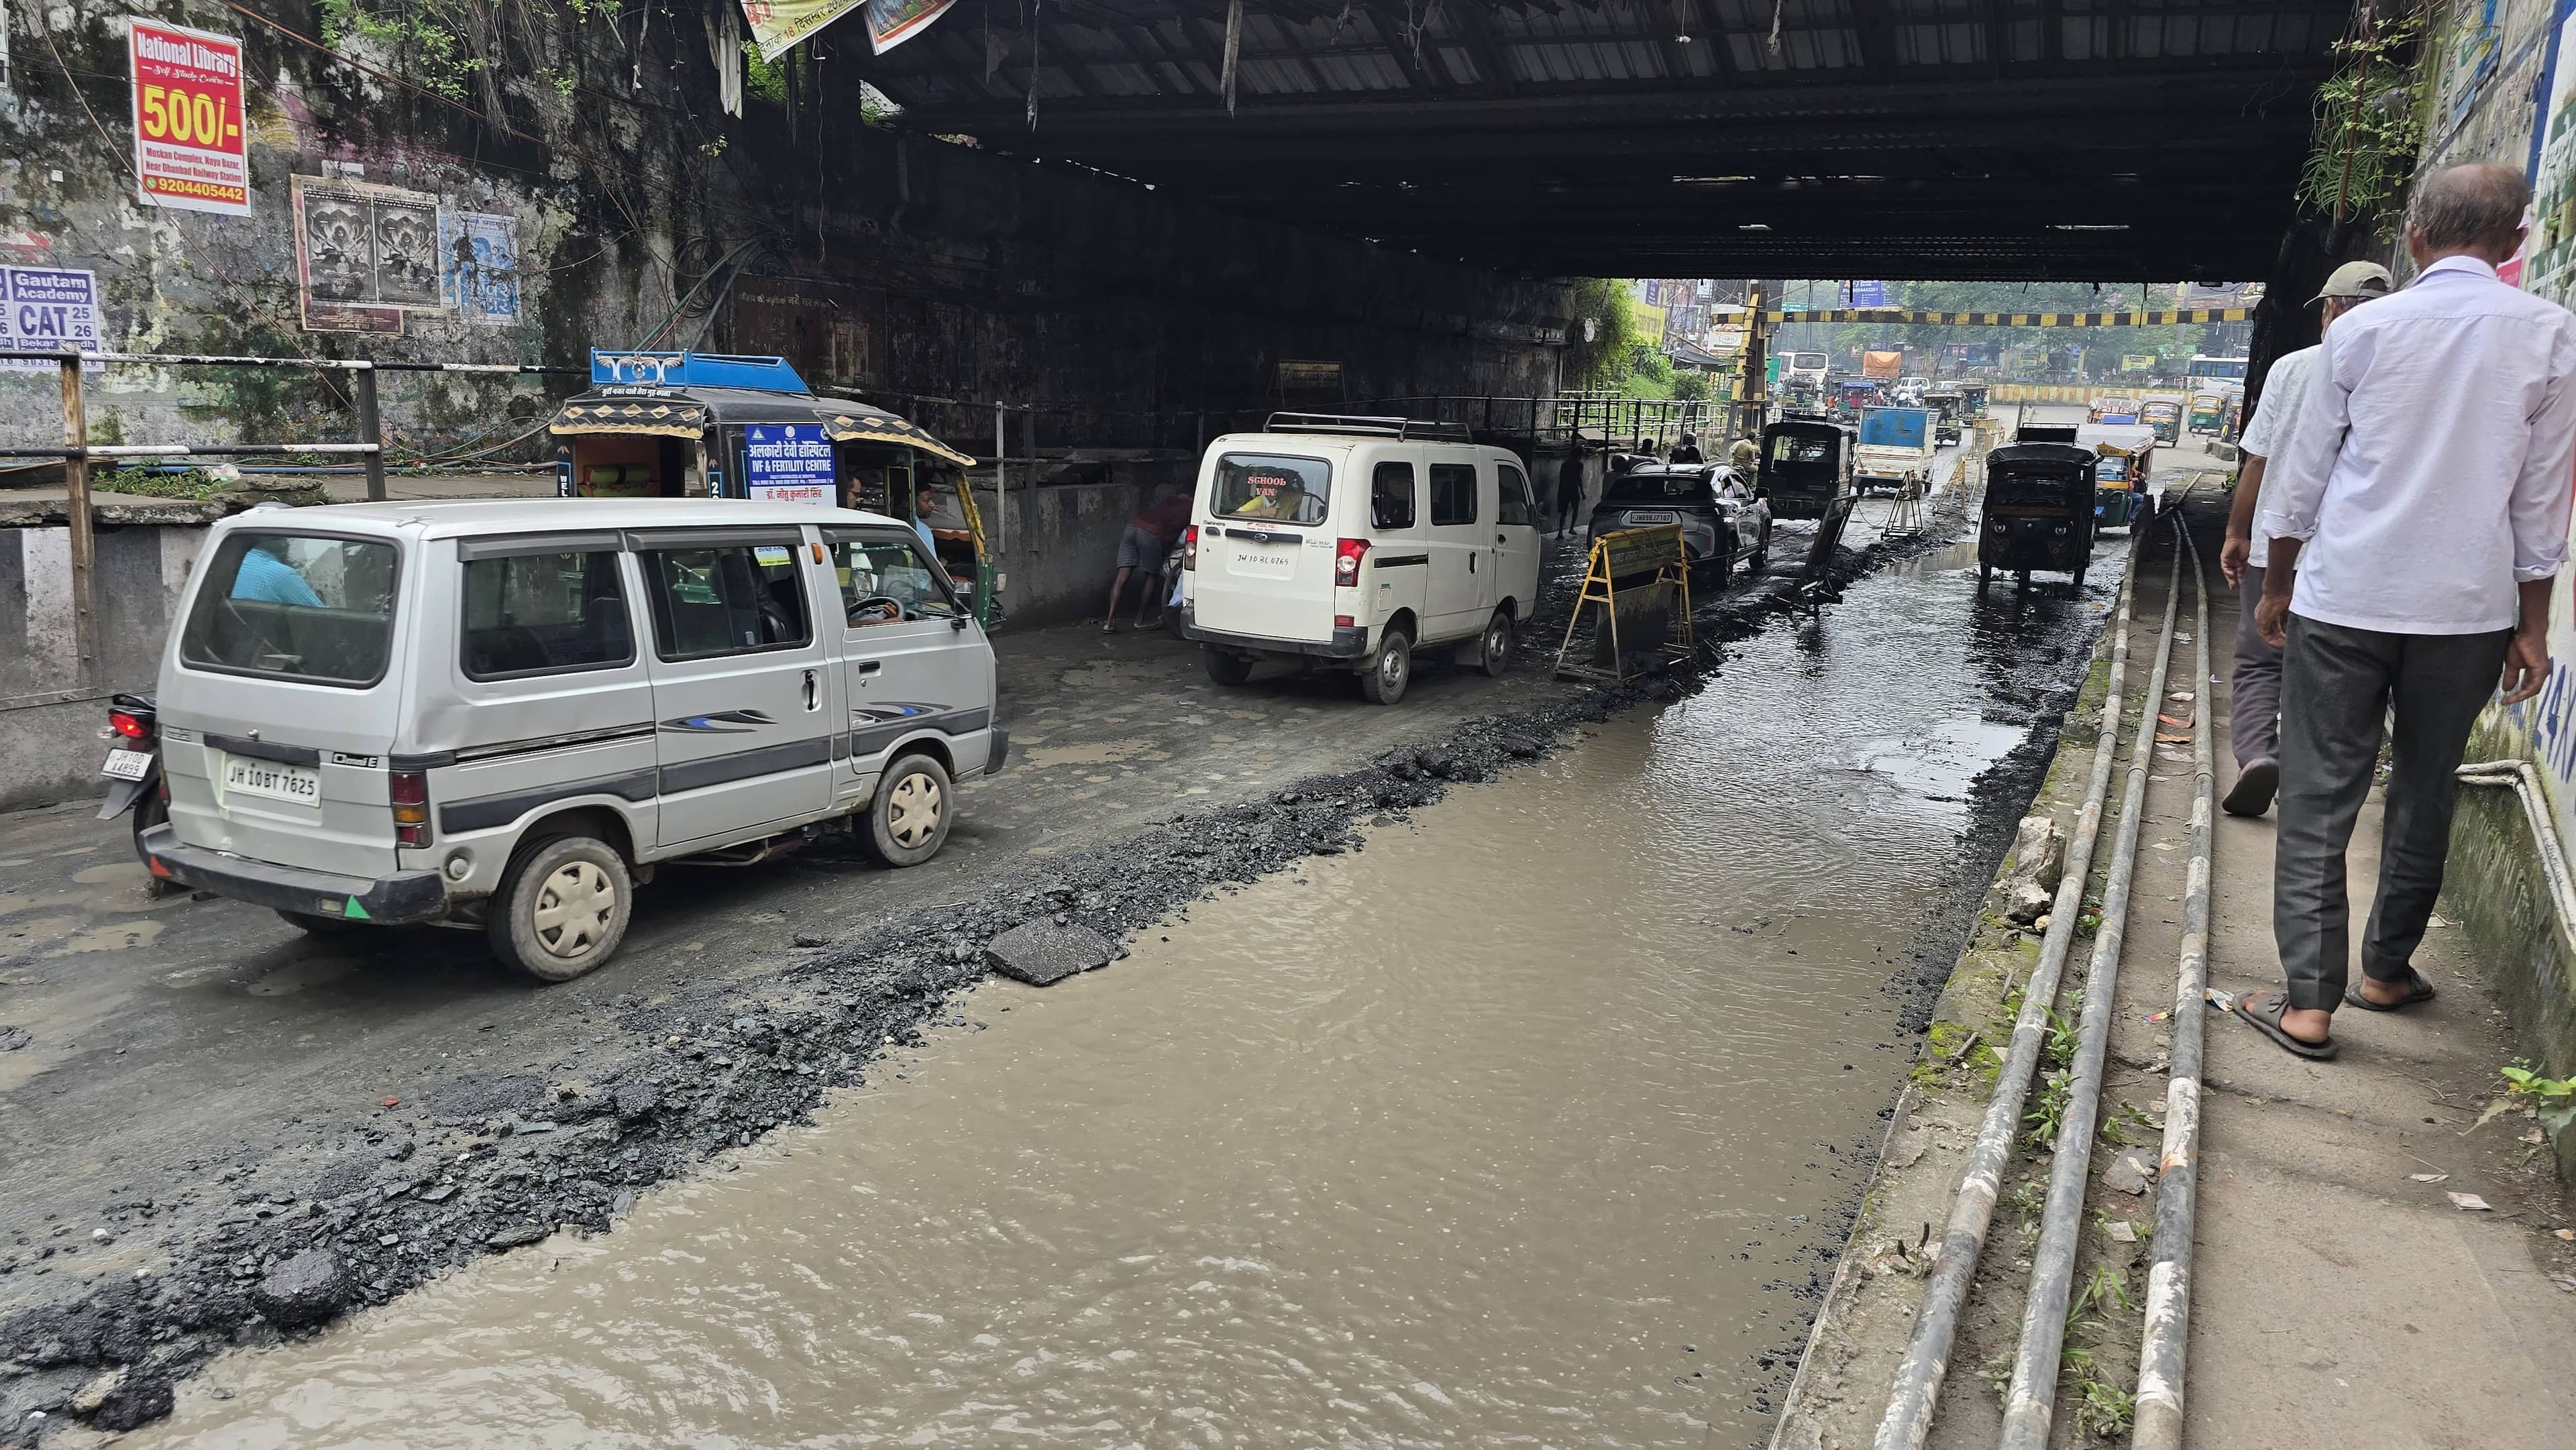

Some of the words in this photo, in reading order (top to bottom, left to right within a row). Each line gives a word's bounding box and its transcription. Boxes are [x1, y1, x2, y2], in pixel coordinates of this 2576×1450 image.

[784, 27, 795, 40] 18
[795, 6, 826, 32] दिसम्बर
[826, 0, 849, 13] 202
[137, 32, 191, 66] National
[193, 44, 236, 77] Library
[153, 65, 170, 76] Self
[172, 69, 197, 82] Study
[199, 74, 225, 85] Centre
[144, 84, 238, 147] 500/-
[146, 148, 172, 160] Muskan
[205, 156, 221, 167] Naya
[146, 161, 161, 171] Near
[162, 164, 191, 176] Dhanbad
[193, 168, 219, 180] Railway
[219, 171, 241, 183] Station
[159, 178, 243, 200] 9204405442
[16, 273, 87, 288] Gautam
[17, 287, 88, 303] Academy
[19, 305, 68, 336] CAT
[72, 307, 90, 319] 25
[74, 325, 92, 337] 26
[749, 441, 782, 457] अलकारी
[783, 441, 797, 457] देवी
[798, 440, 831, 457] हॉस्पिटल
[752, 460, 763, 472] IVF
[765, 460, 771, 472] &
[772, 460, 804, 472] FERTILITY
[806, 459, 831, 471] CENTRE
[1247, 476, 1287, 486] SCHOOL
[789, 488, 808, 502] कुमारी
[230, 767, 244, 784] JH
[283, 776, 315, 795] 7625
